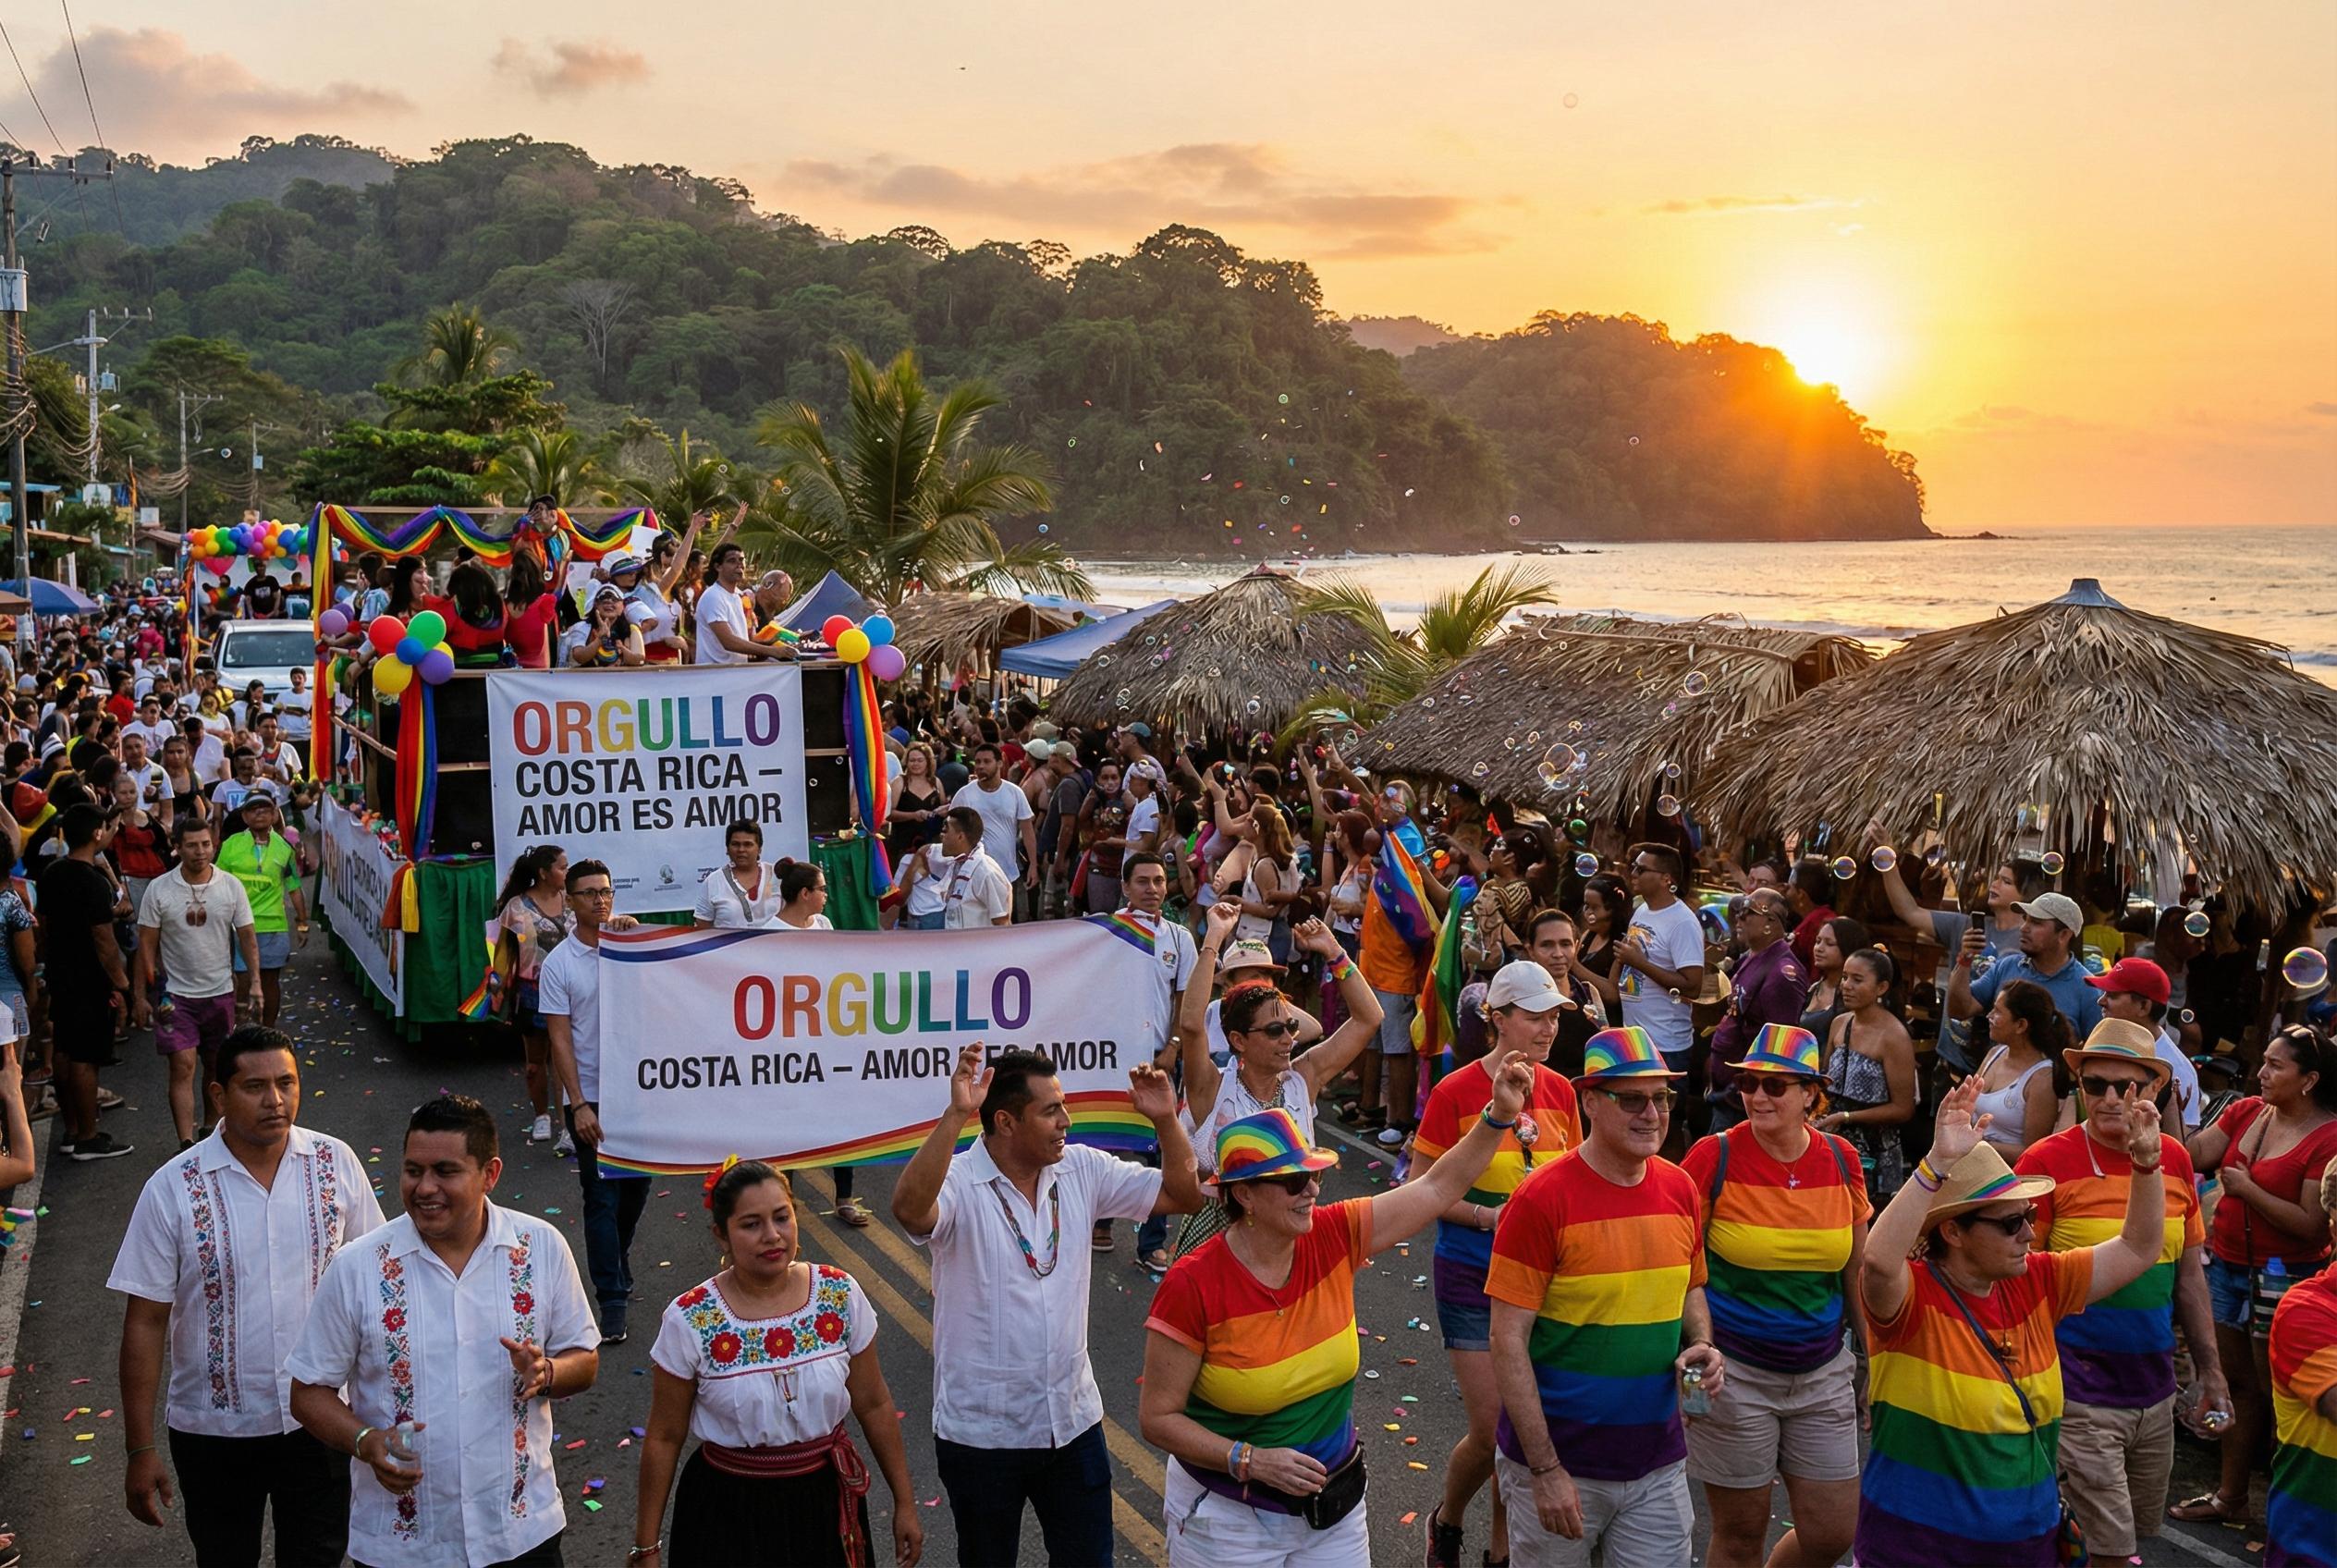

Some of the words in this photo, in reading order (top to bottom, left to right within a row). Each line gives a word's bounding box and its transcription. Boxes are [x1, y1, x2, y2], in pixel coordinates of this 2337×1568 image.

[512, 693, 781, 756] ORGULLO
[516, 758, 645, 798] COSTA
[657, 753, 749, 791] RICA
[517, 801, 621, 837] AMOR
[632, 797, 674, 830] ES
[684, 792, 782, 828] AMOR
[733, 966, 1032, 1041] ORGULLO
[638, 1055, 741, 1090] COSTA
[752, 1052, 825, 1085] RICA
[861, 1046, 951, 1081] AMOR
